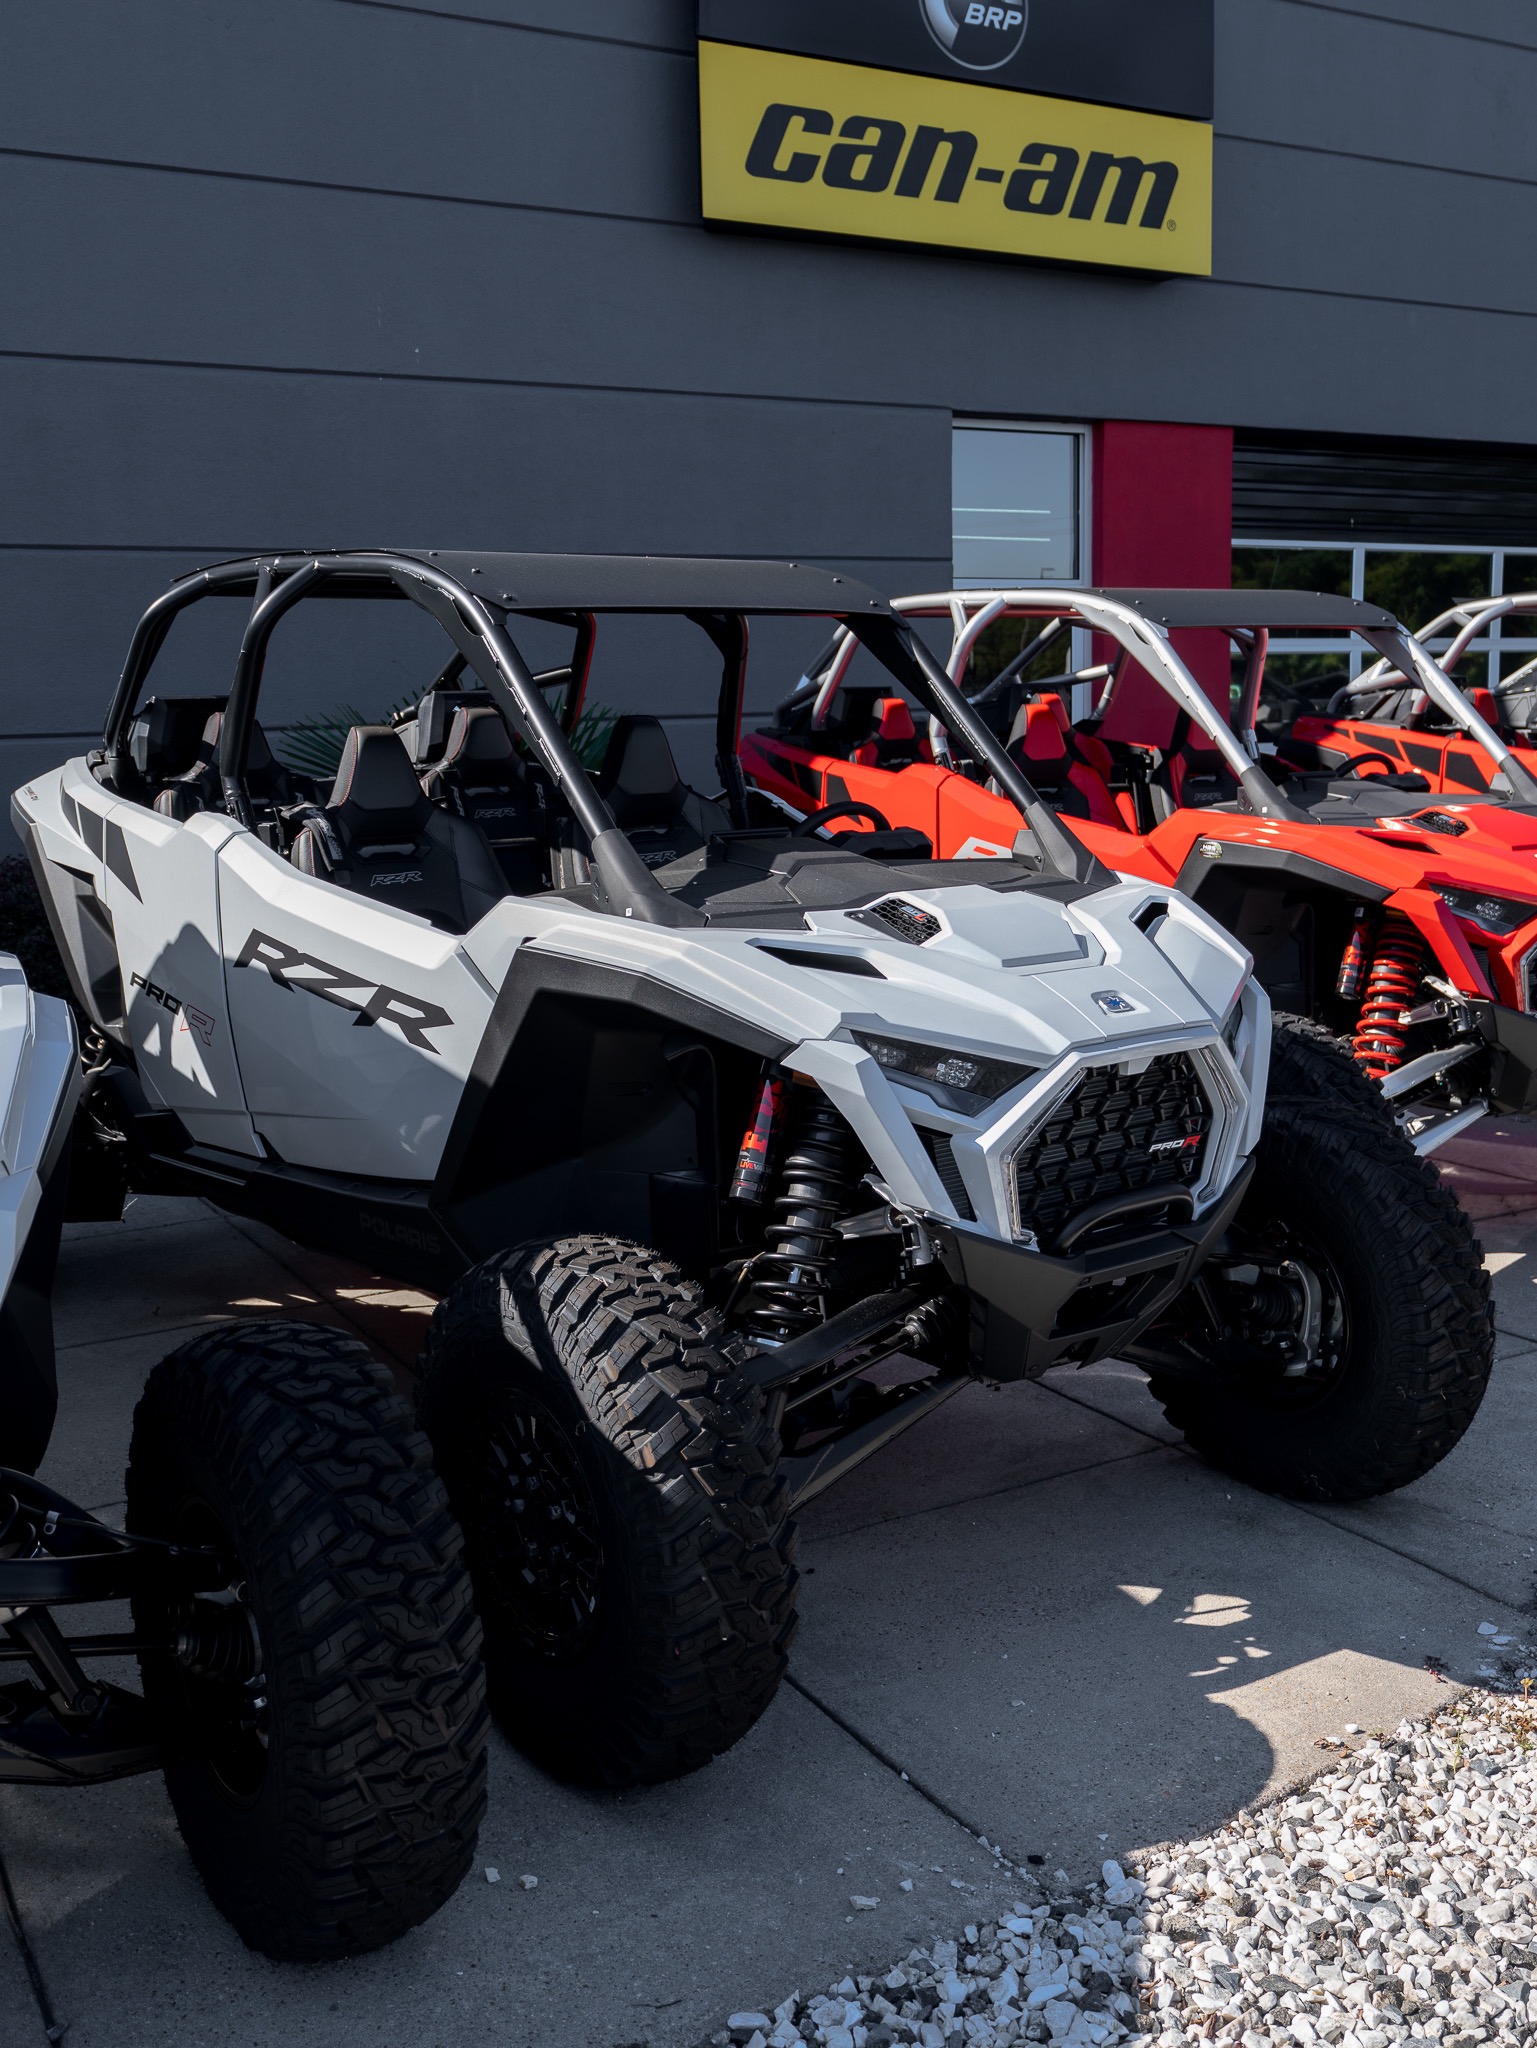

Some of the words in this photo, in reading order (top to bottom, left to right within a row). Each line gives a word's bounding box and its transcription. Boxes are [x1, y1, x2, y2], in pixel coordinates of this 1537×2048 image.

[964, 2, 1023, 31] BRP
[474, 807, 516, 819] RZR
[370, 871, 424, 887] RZR
[130, 971, 183, 1016] PRO
[233, 928, 454, 1055] RZR
[359, 1212, 441, 1255] POLARIS
